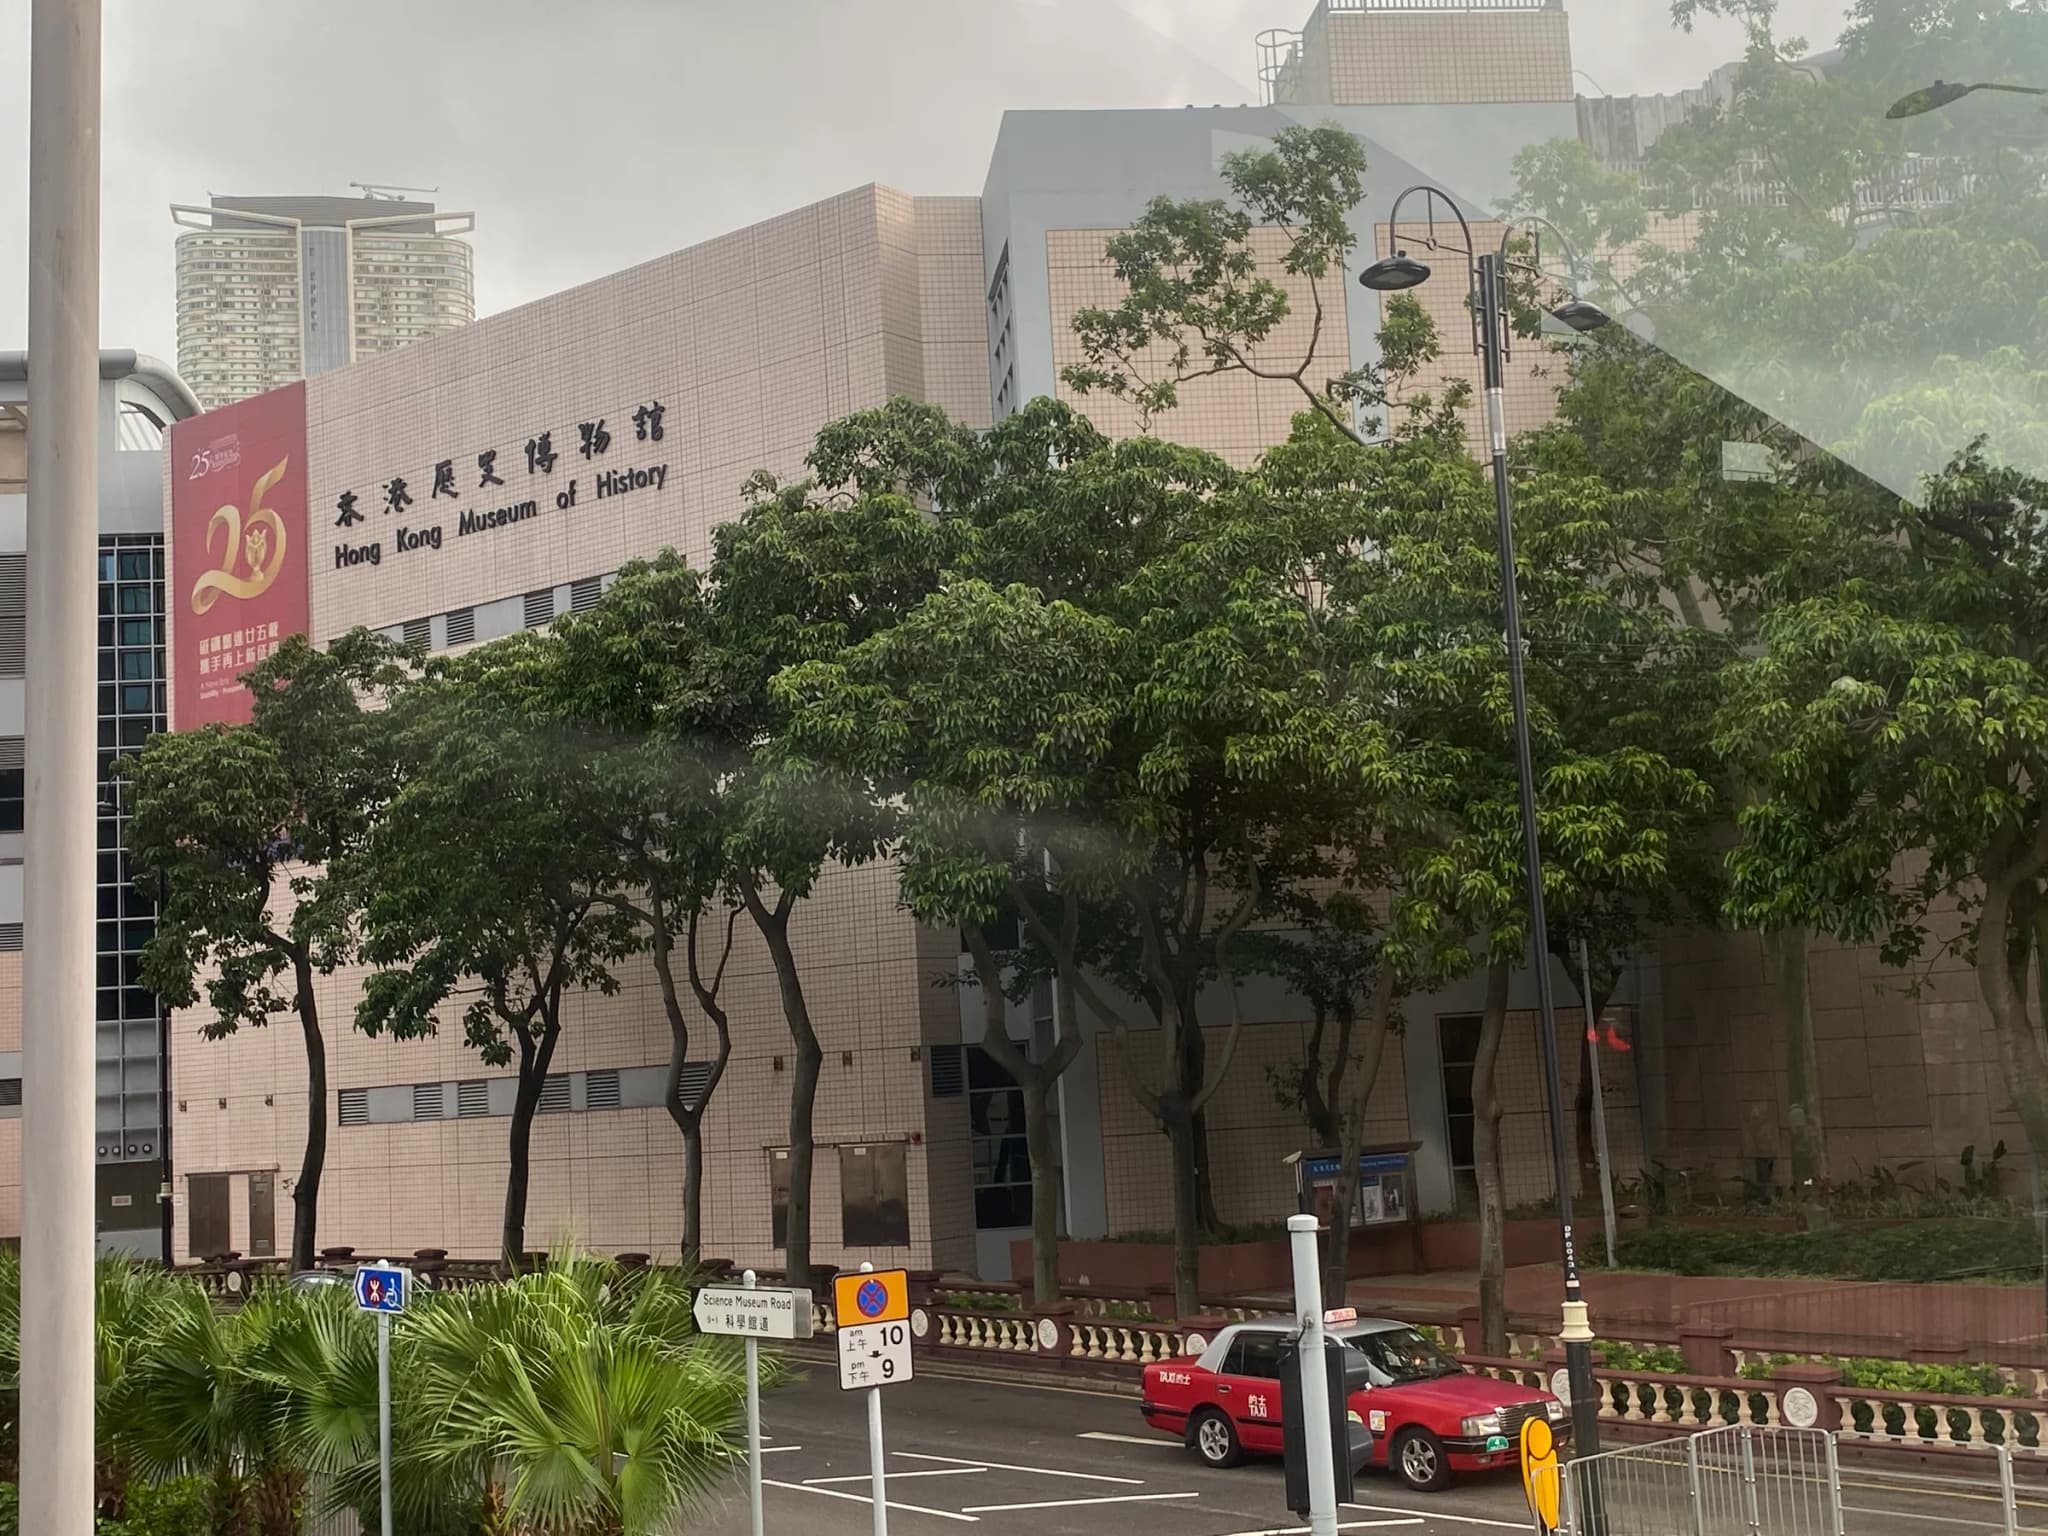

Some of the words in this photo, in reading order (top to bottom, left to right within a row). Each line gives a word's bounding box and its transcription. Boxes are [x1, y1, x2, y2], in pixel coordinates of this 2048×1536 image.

[188, 449, 211, 480] 25
[335, 401, 666, 527] 香港歷史博物館
[335, 543, 381, 569] Hong
[396, 526, 442, 552] Kong
[458, 500, 537, 537] Museum
[556, 479, 576, 509] of
[596, 464, 667, 499] History
[703, 1293, 733, 1306] Science
[735, 1296, 768, 1309] Museum
[770, 1297, 791, 1310] Road
[725, 1314, 769, 1332] 科學館道
[849, 1329, 863, 1337] am
[880, 1325, 903, 1346] 10
[846, 1339, 867, 1352] 上午
[851, 1361, 865, 1370] pm
[882, 1358, 894, 1379] 9
[848, 1371, 869, 1385] 下午
[1159, 1371, 1176, 1383] TAXI
[1176, 1373, 1191, 1386] 的士
[1248, 1394, 1267, 1406] 的士
[1249, 1404, 1268, 1418] TAXI
